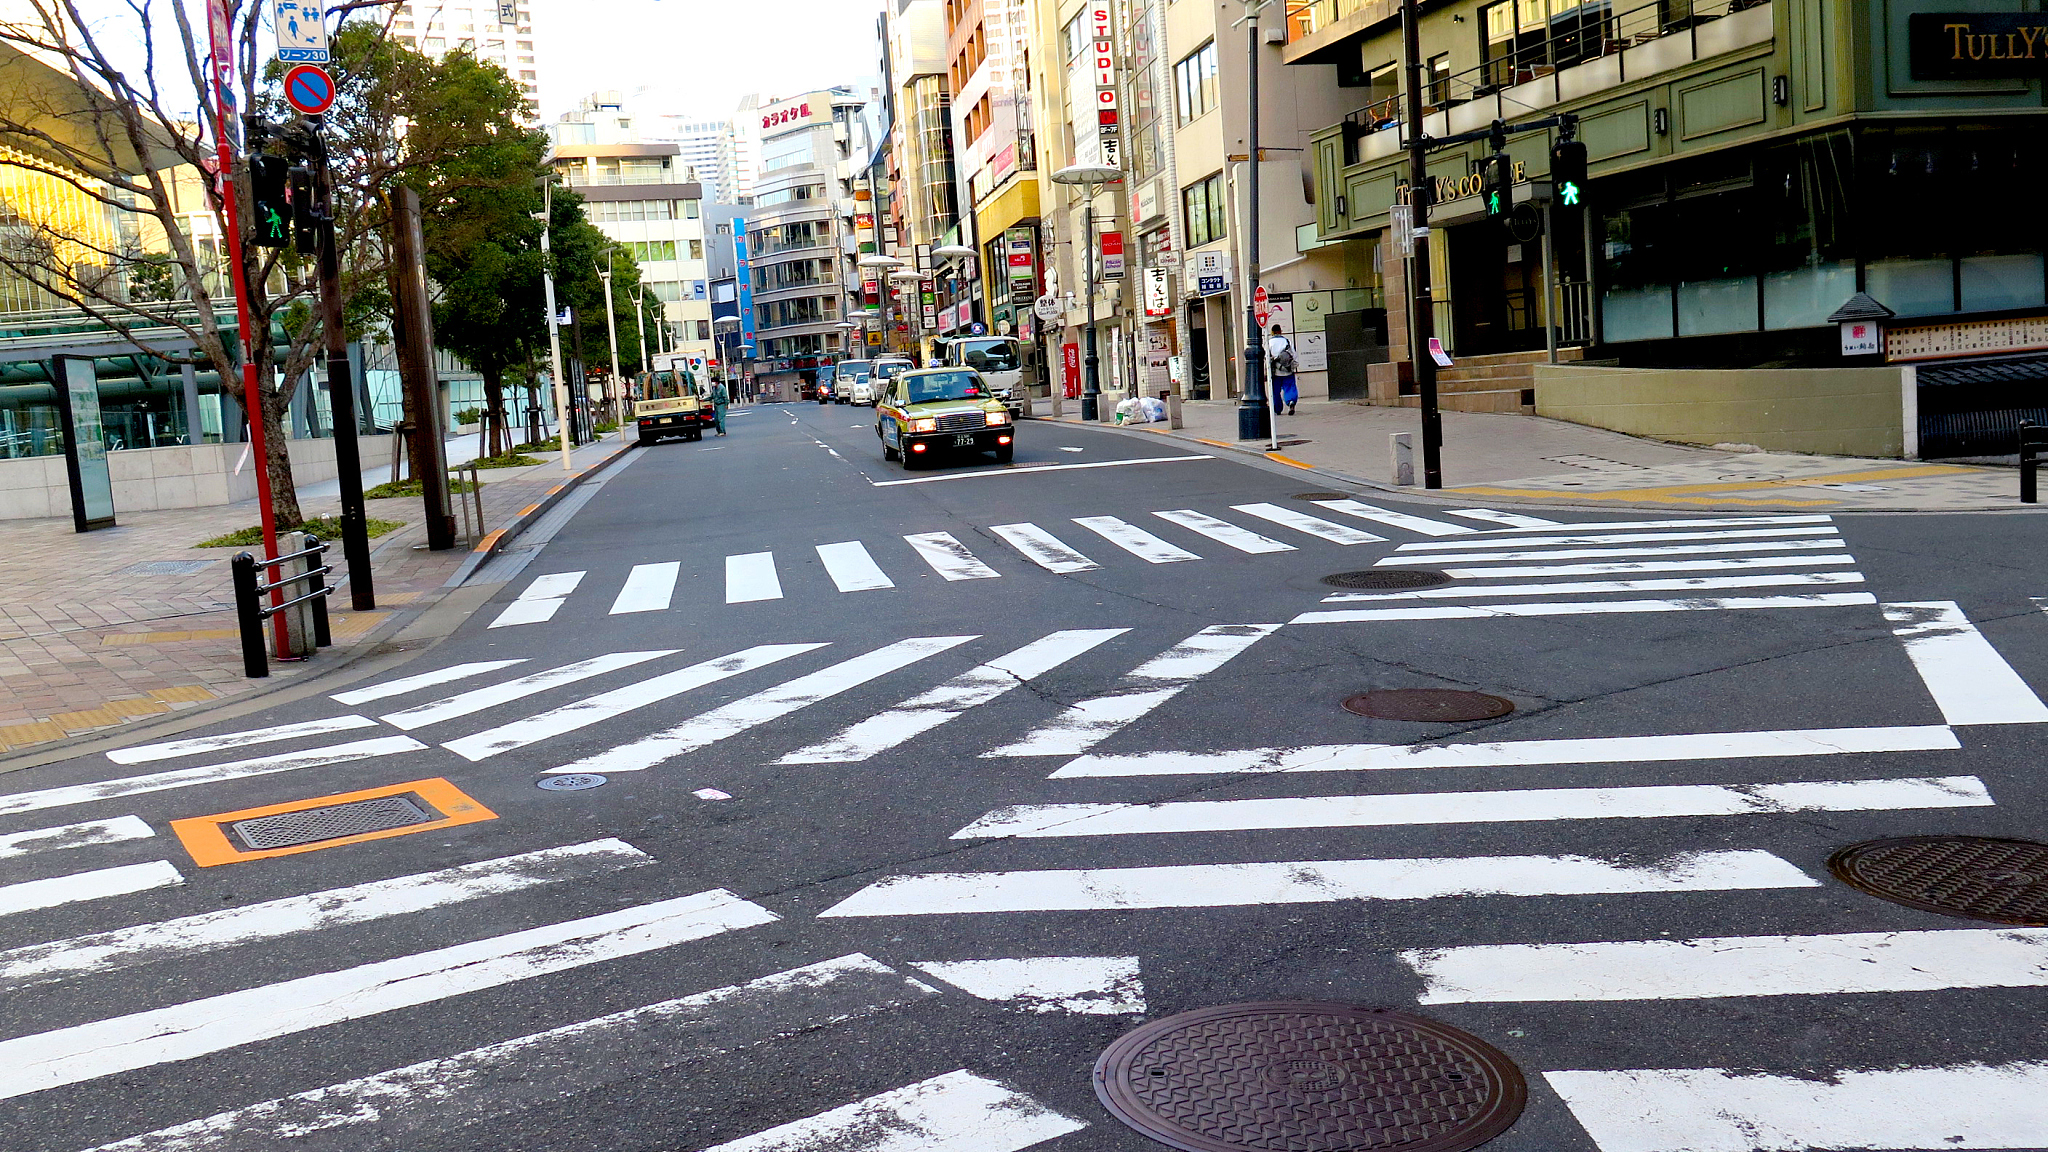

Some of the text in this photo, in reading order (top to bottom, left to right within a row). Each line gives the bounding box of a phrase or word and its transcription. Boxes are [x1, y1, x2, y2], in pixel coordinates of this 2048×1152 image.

[1094, 10, 1113, 103] STUDIO
[1103, 139, 1119, 169] 吉そ
[1458, 160, 1526, 197] COE
[1150, 268, 1168, 308] 吉そば
